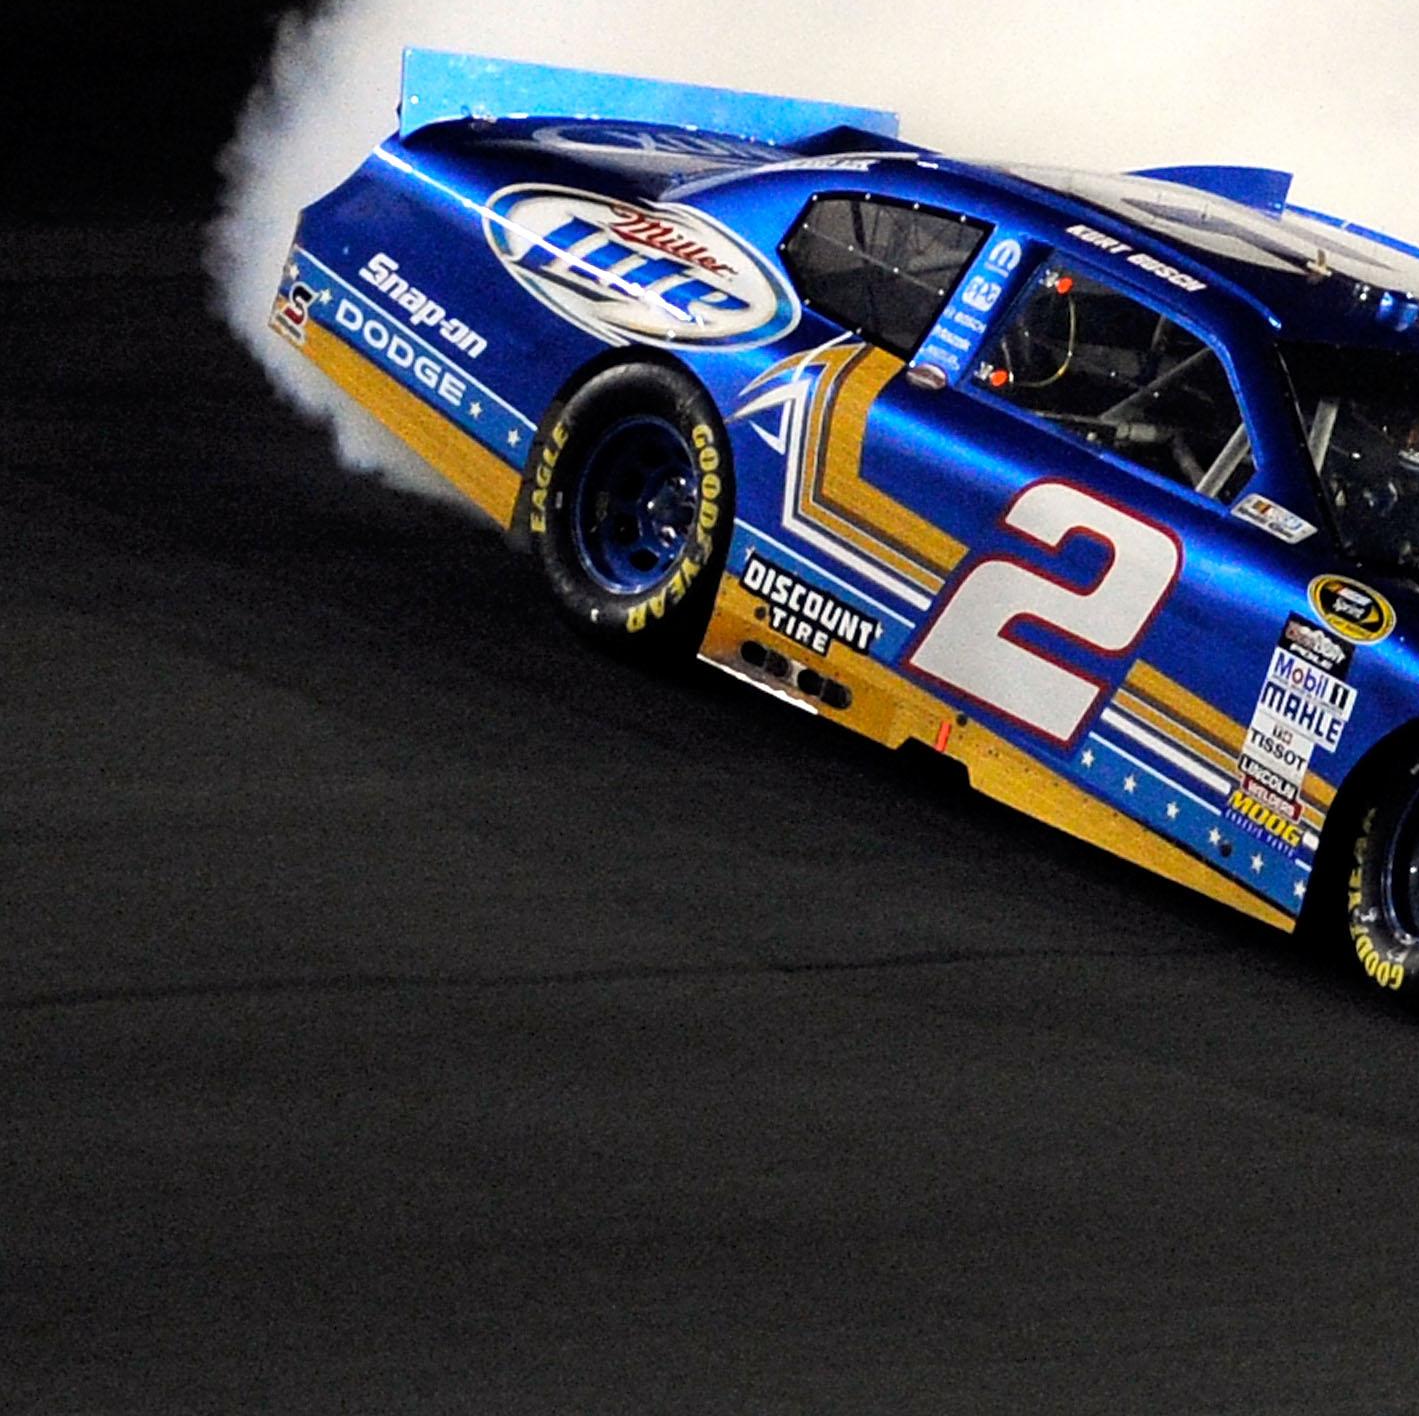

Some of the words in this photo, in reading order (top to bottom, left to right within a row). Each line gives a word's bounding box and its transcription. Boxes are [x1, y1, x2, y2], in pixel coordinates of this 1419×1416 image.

[606, 204, 739, 281] Miller
[1065, 224, 1133, 254] KURT
[1126, 253, 1207, 292] BUSCH
[358, 251, 488, 359] Snap-on
[335, 298, 467, 406] DODGE
[530, 421, 569, 533] EAGLE
[744, 559, 873, 649] DISCOUNT
[773, 606, 829, 654] TIRE
[904, 476, 1183, 748] 2
[1261, 681, 1342, 744] MAHLE
[1274, 652, 1328, 700] Mobil
[1329, 683, 1349, 710] 1
[1241, 755, 1298, 800] LINCOLN
[1251, 727, 1306, 772] TISSOT
[1228, 789, 1300, 847] MOOG
